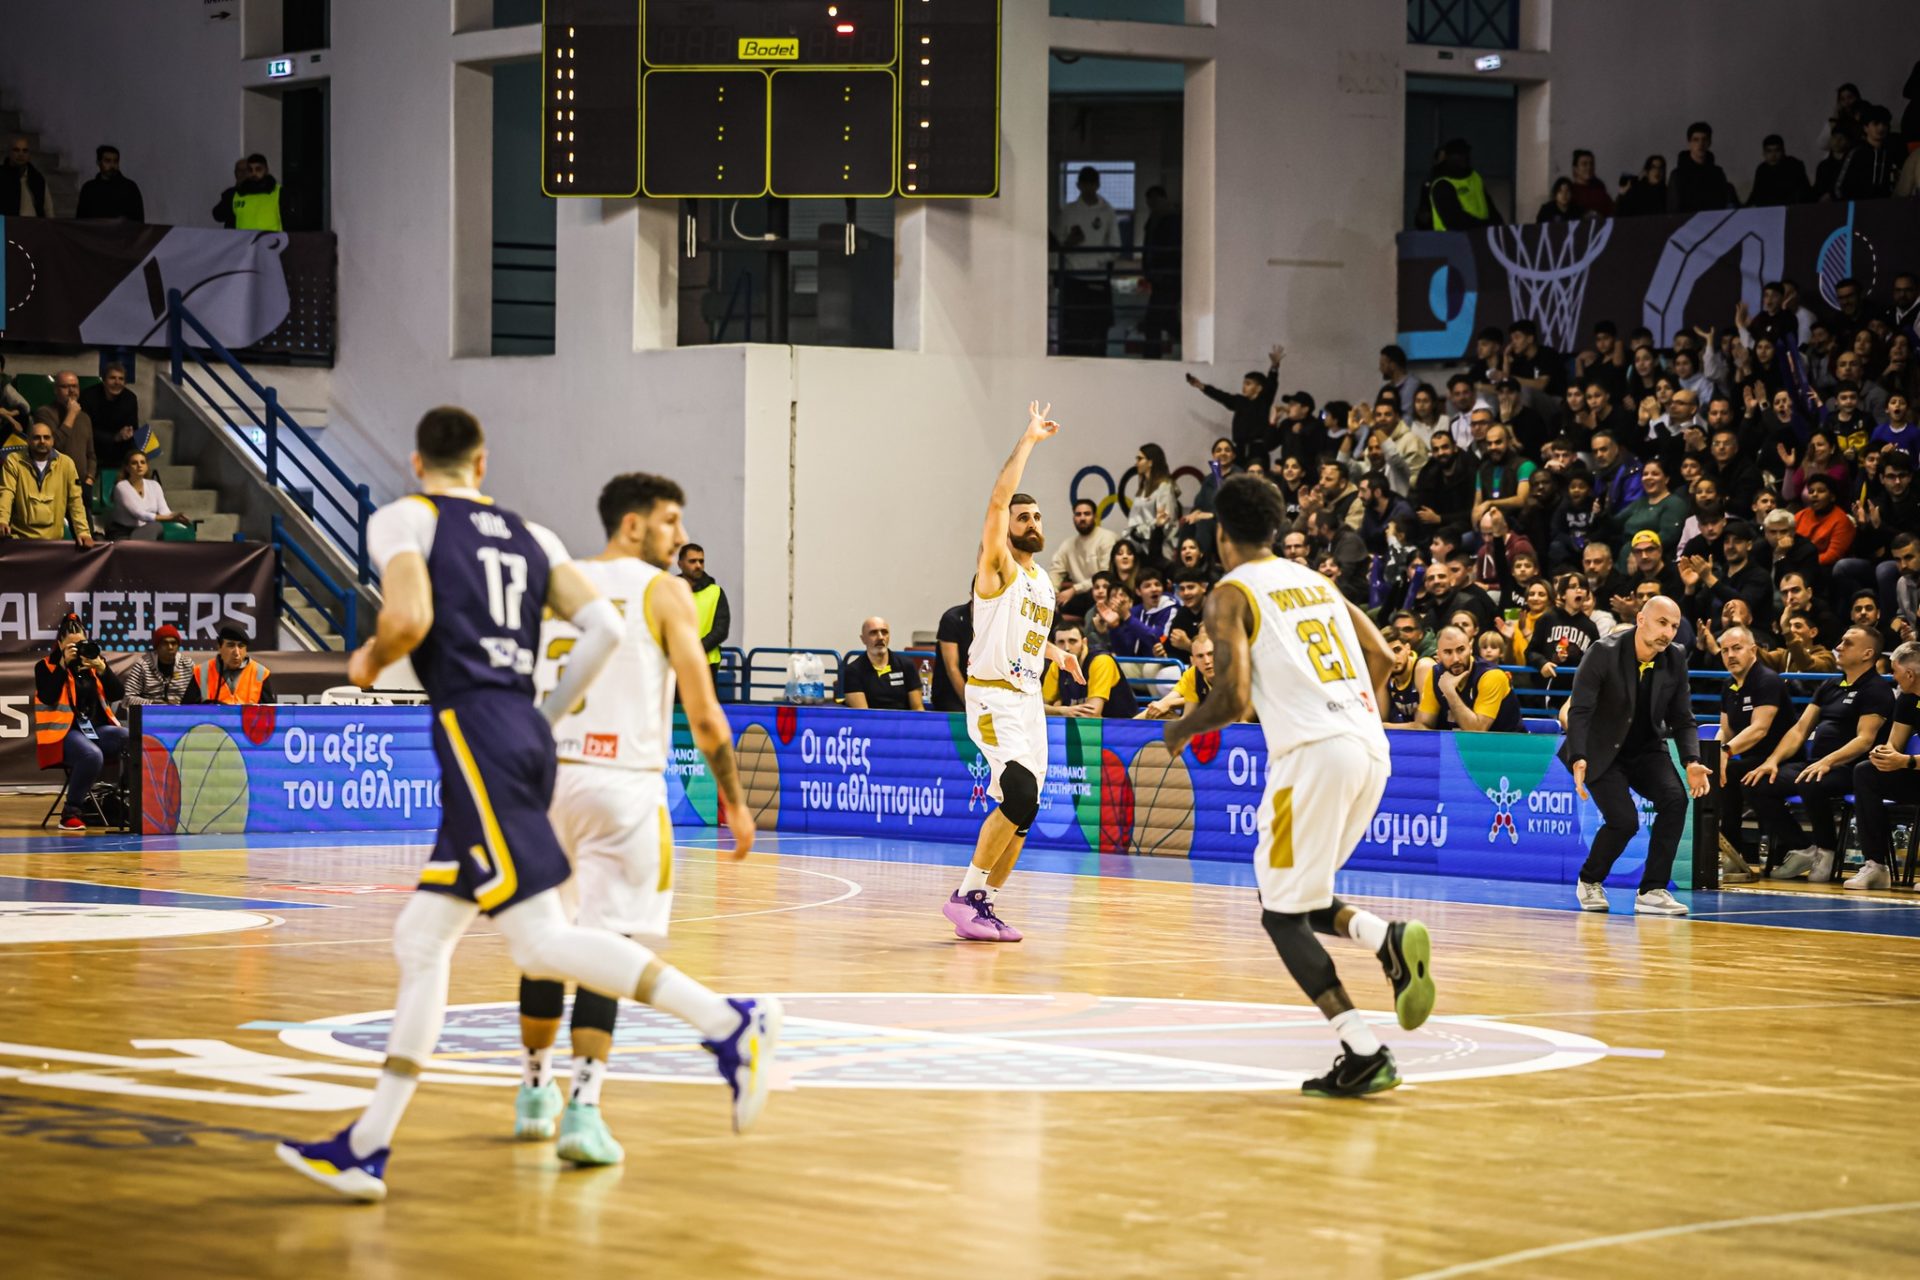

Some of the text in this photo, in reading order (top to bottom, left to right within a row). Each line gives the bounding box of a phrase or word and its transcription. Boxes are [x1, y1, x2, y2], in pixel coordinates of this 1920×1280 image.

[743, 41, 795, 56] Bodet
[1296, 617, 1356, 683] 21
[1546, 626, 1591, 652] JORDAN
[284, 723, 394, 772] Οι αξίες
[801, 726, 872, 775] Οι αξίες
[283, 780, 334, 810] του
[800, 773, 945, 826] του αθλητισμού
[1528, 818, 1572, 836] ΚΥΠΡΟΥ
